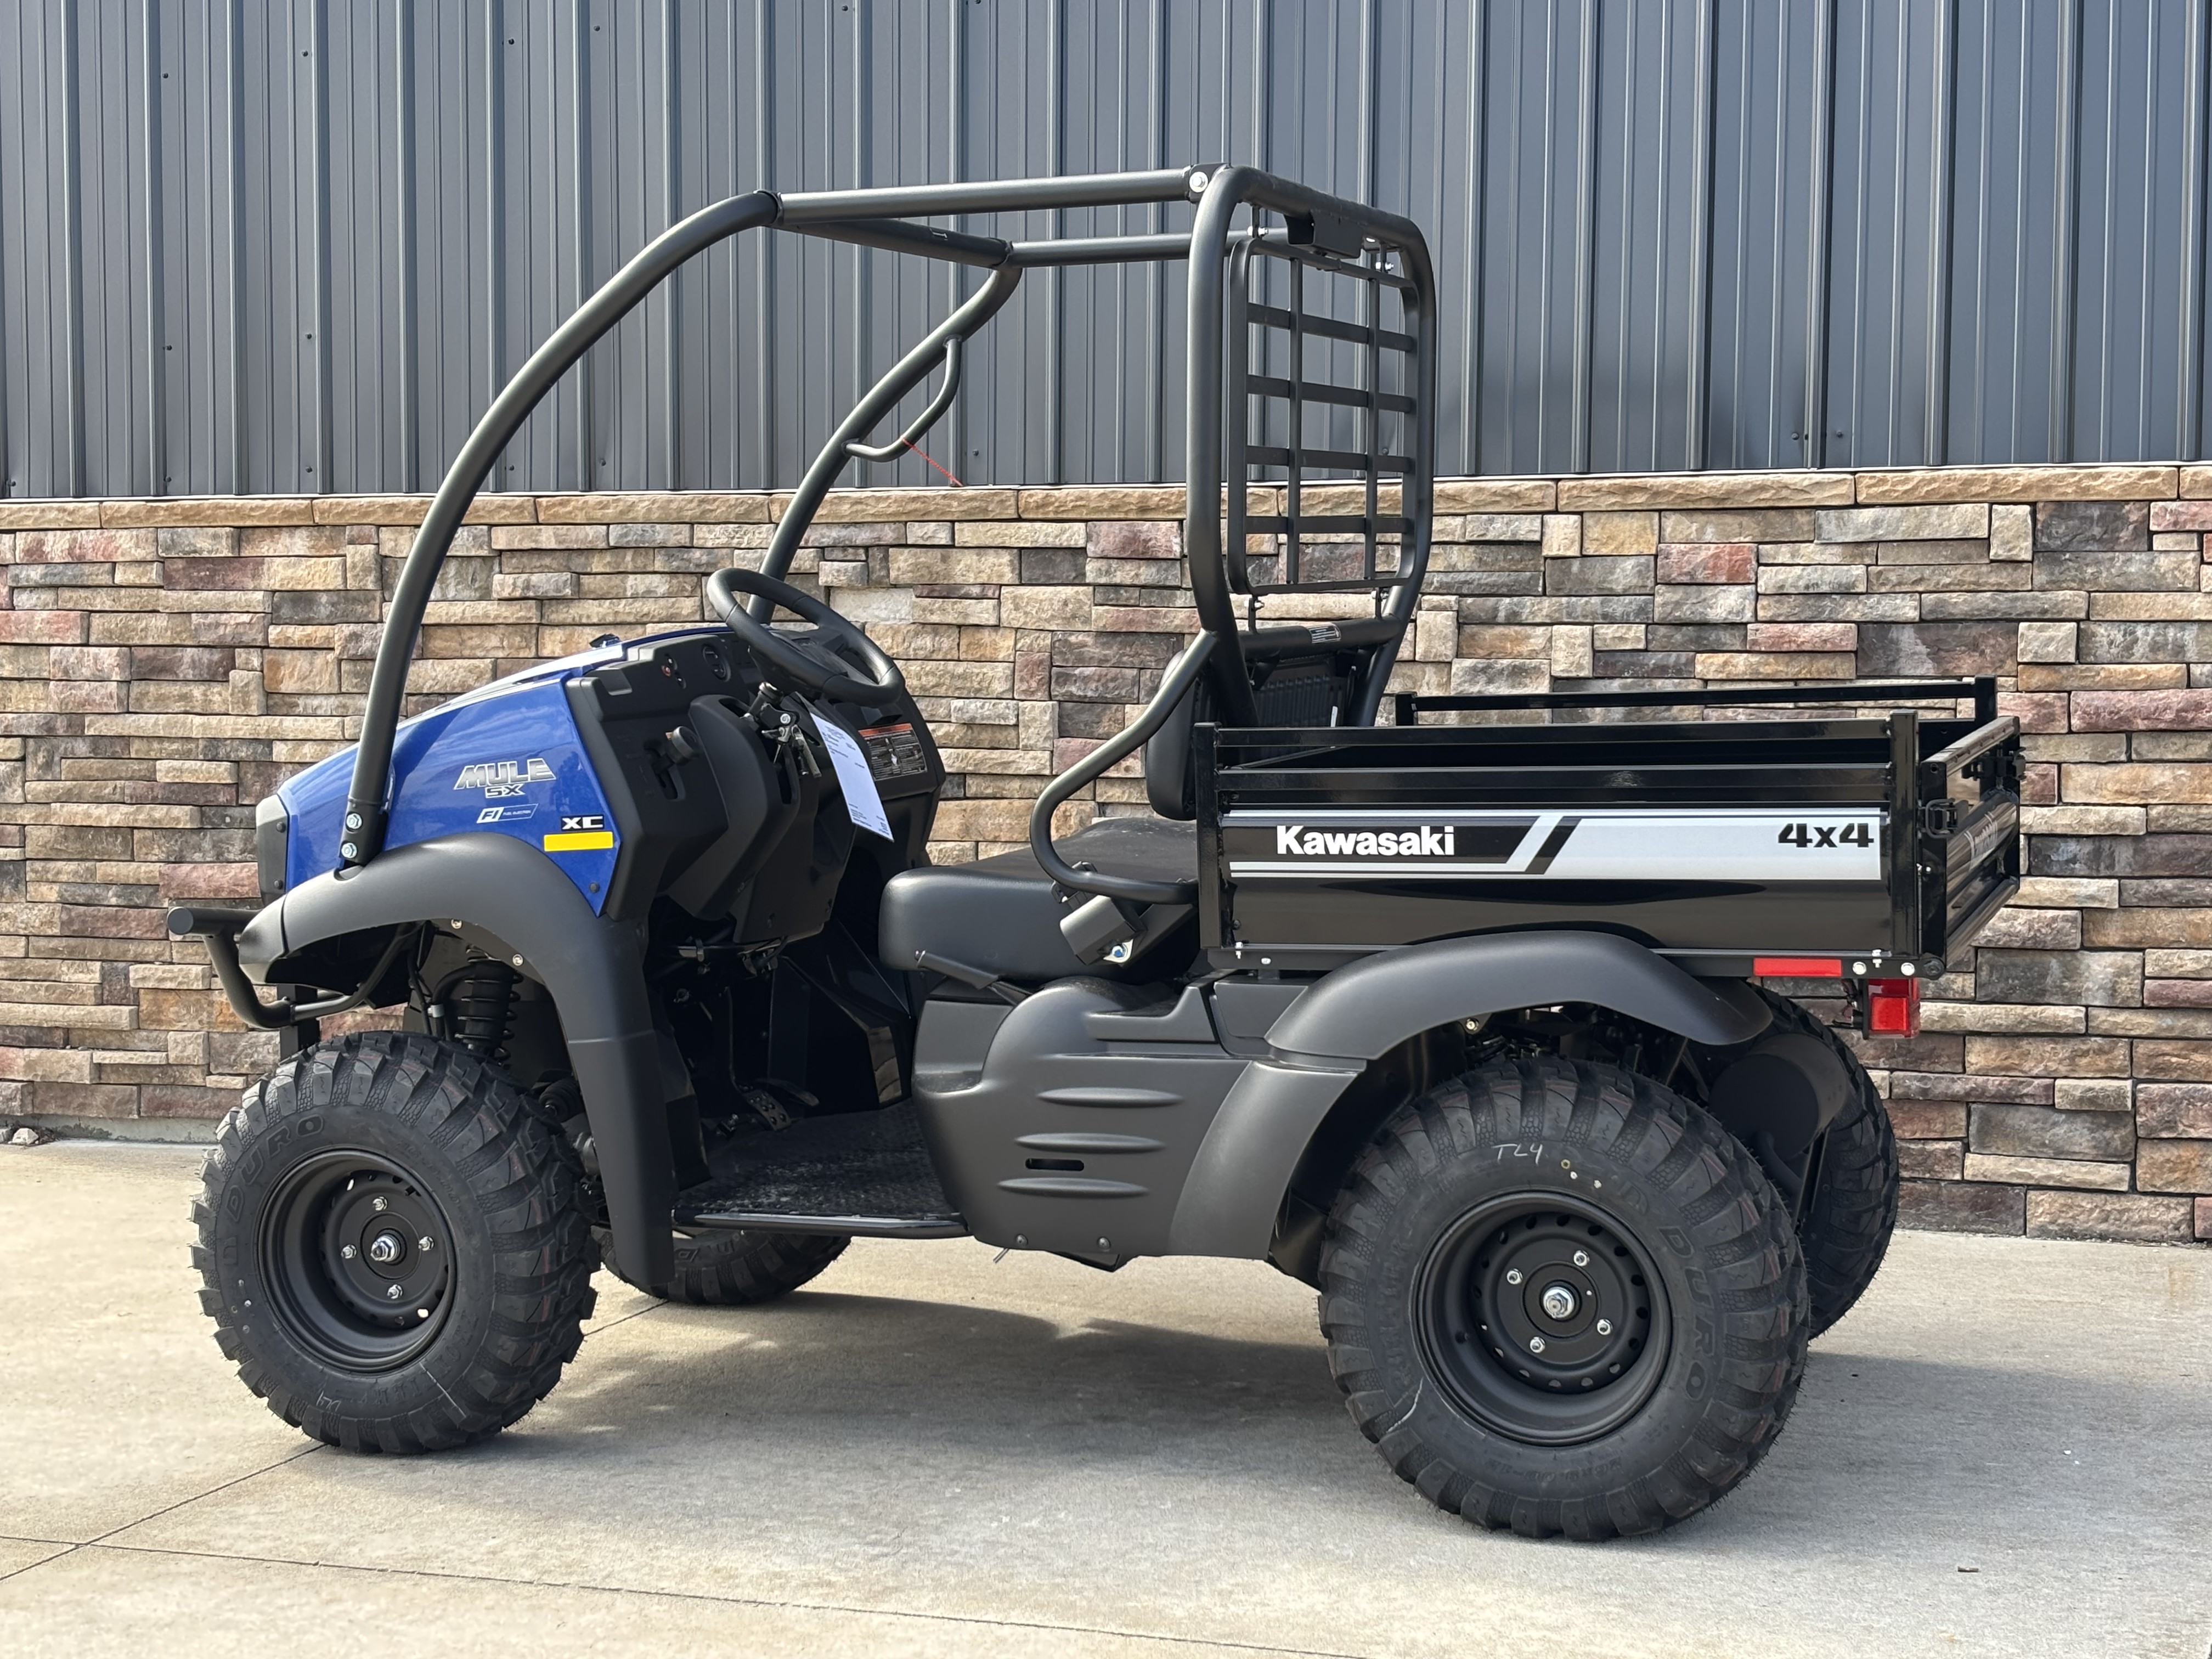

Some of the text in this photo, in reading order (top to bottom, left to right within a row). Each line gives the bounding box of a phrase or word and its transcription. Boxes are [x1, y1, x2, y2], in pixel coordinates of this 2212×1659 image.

[453, 758, 557, 790] MULE
[484, 783, 526, 799] SX
[481, 810, 500, 820] FI
[562, 816, 603, 830] XC
[1276, 825, 1455, 856] Kawasaki
[1778, 823, 1875, 848] 4x4
[228, 1115, 324, 1222] DURO
[1660, 1227, 1716, 1400] DURO
